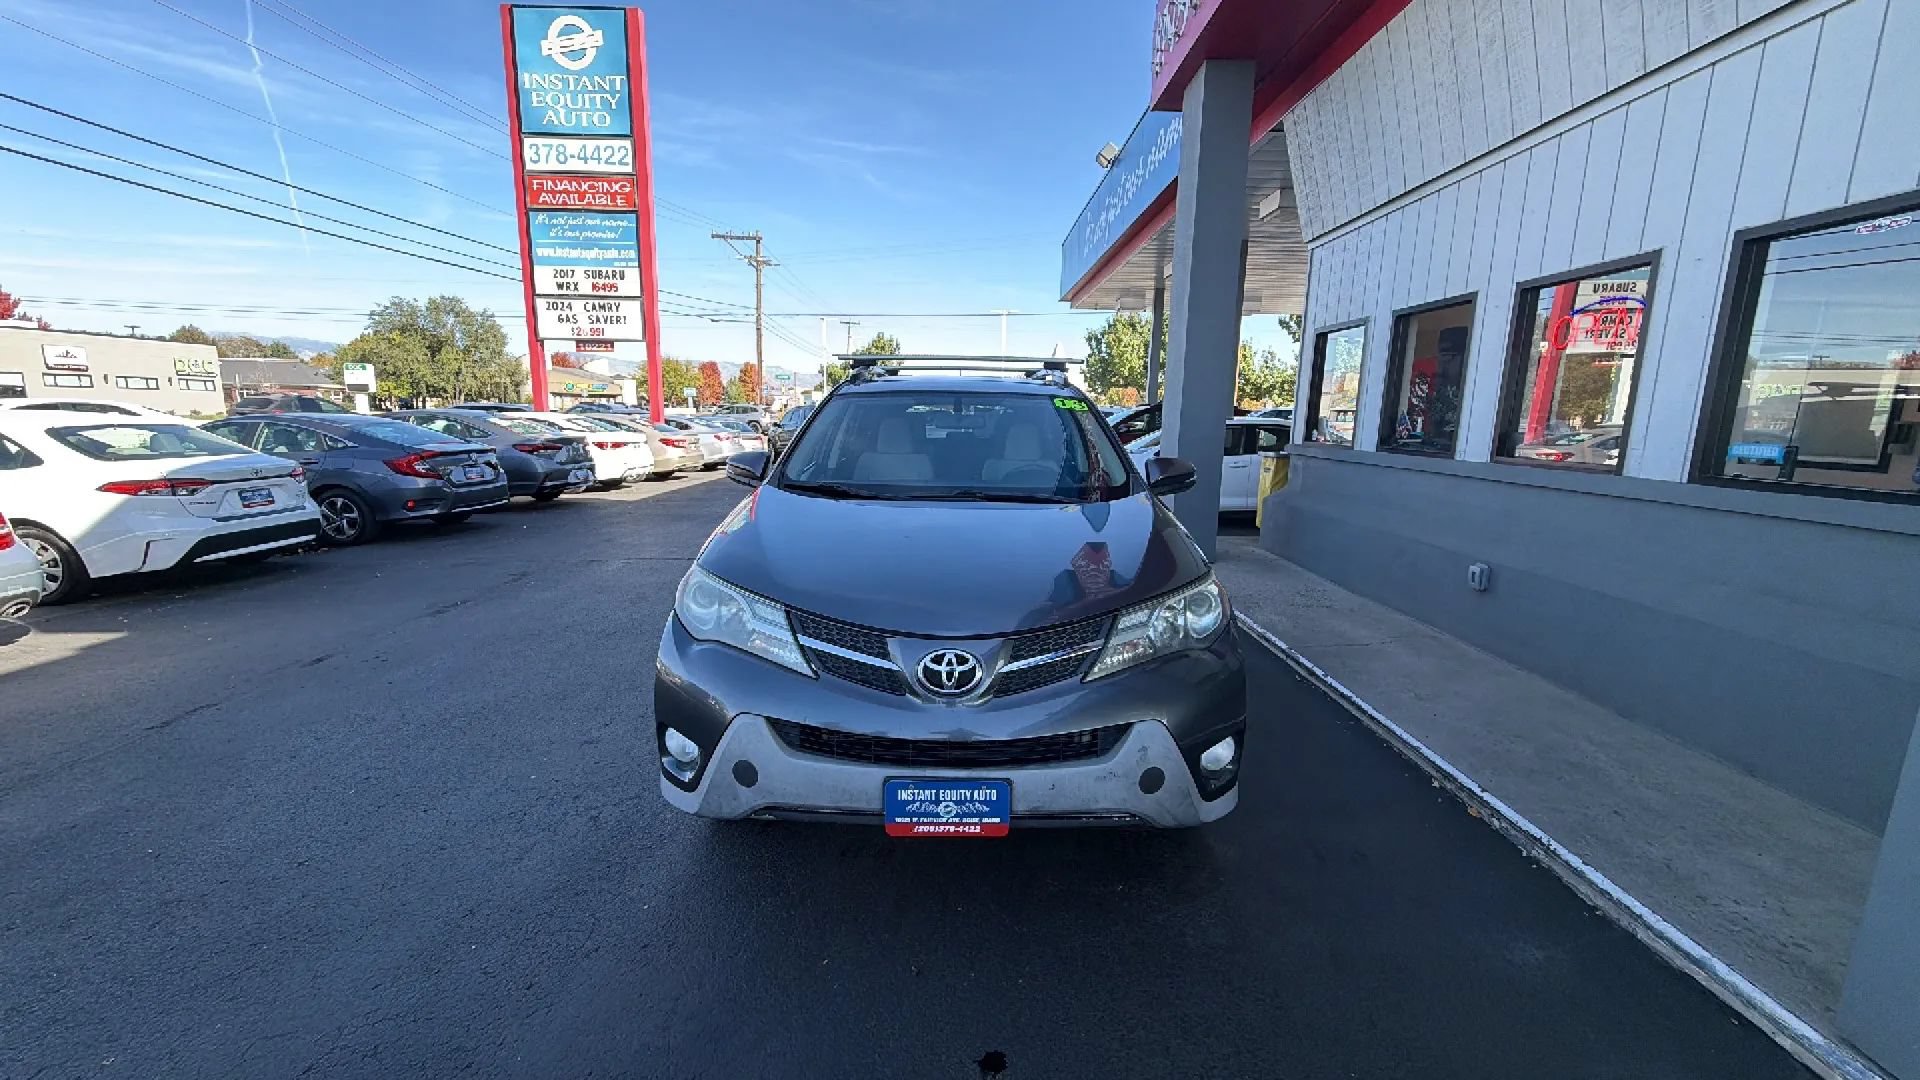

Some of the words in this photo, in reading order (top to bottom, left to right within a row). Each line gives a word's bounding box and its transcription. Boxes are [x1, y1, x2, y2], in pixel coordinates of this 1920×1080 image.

[522, 72, 626, 91] INSTANT
[531, 91, 620, 110] EQUITY
[542, 110, 611, 127] AUTO
[529, 143, 630, 166] 378-4422
[532, 179, 632, 193] FINANCING
[538, 193, 628, 206] AVAILABLE
[553, 269, 575, 279] 2017
[583, 269, 625, 280] SUBARU
[555, 281, 579, 292] WRX
[591, 281, 619, 293] 16495
[545, 301, 573, 312] 2024
[583, 302, 621, 312] CAMRY
[557, 314, 579, 324] GAS
[898, 789, 936, 801] INSTANT
[940, 789, 972, 801] EQUITY
[973, 789, 997, 801] AUTO
